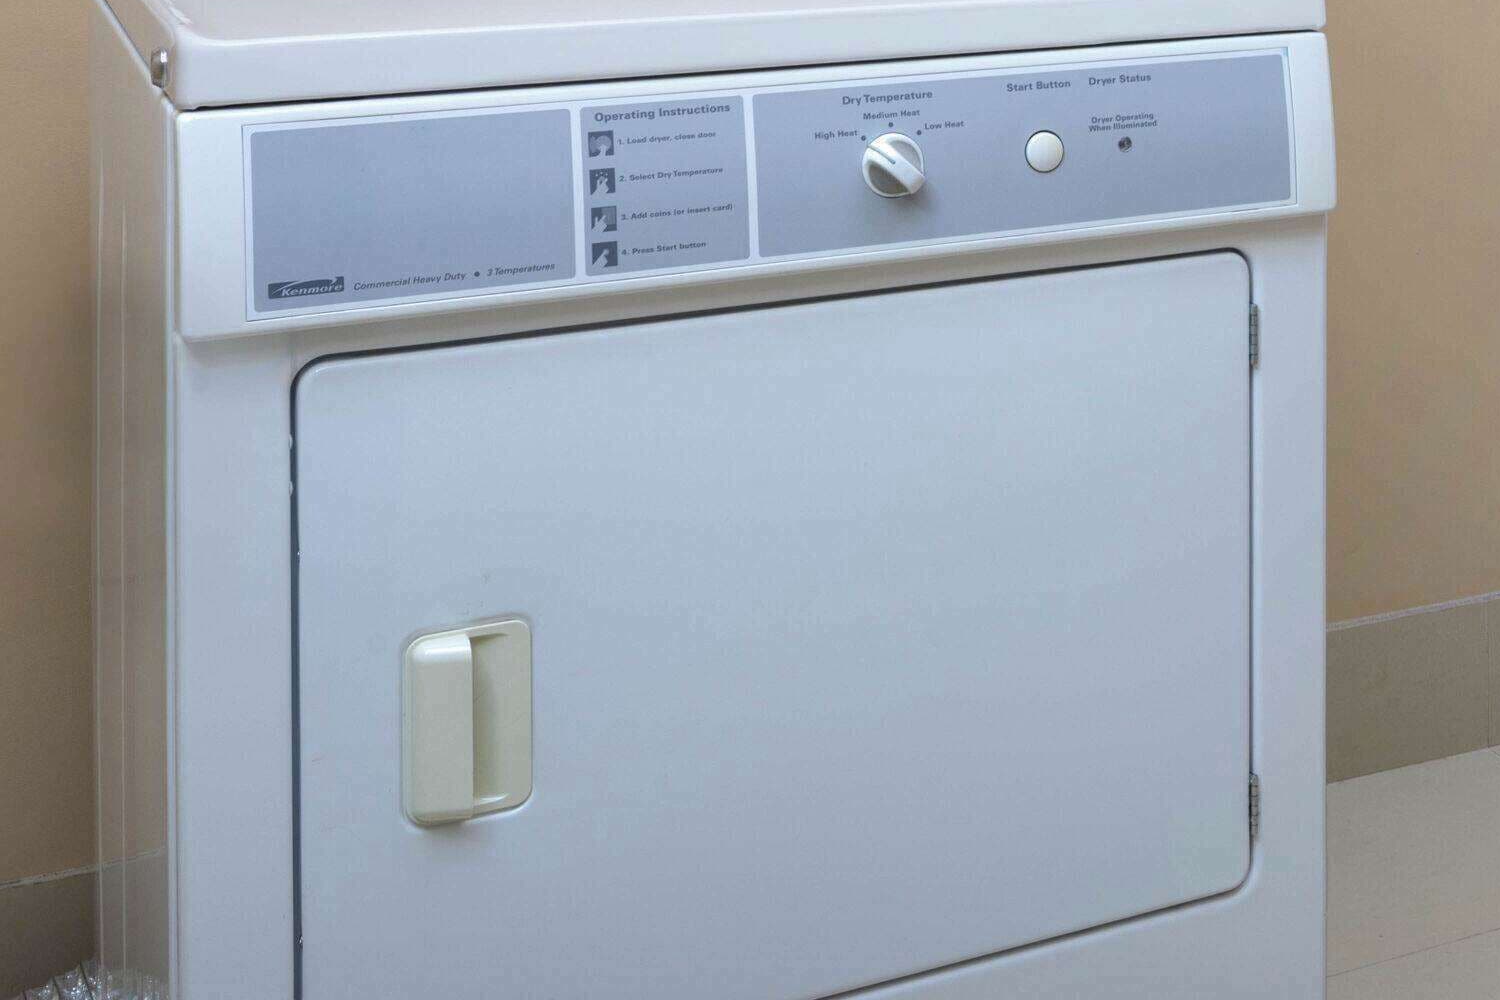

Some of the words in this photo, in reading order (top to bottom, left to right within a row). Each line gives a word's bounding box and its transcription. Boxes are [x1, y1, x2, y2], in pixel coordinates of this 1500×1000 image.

[1006, 83, 1033, 93] Start
[1036, 80, 1071, 90] Button
[1088, 77, 1116, 87] Dryer
[1119, 74, 1151, 84] Status
[842, 95, 861, 106] Dry
[863, 90, 933, 104] Temperature
[594, 109, 655, 123] Operating
[659, 104, 731, 118] Instructions
[863, 112, 898, 120] Medium
[900, 109, 920, 117] Heat
[1091, 115, 1113, 124] Dryer
[1115, 112, 1154, 122] Operating
[924, 122, 942, 131] Low
[944, 120, 964, 128] Heat
[1089, 124, 1111, 133] When
[1113, 120, 1157, 131] Illuminated
[627, 136, 647, 145] Load
[674, 132, 696, 141] close
[698, 131, 716, 139] door
[814, 131, 835, 141] High
[837, 129, 858, 137] Heat
[629, 173, 655, 182] Select
[657, 172, 673, 180] Dry
[674, 168, 724, 179] Temperature
[631, 211, 648, 220] Add
[650, 210, 672, 218] coins
[673, 208, 685, 217] (or
[687, 206, 711, 215] insert
[712, 203, 733, 212] card)
[632, 246, 655, 255] Press
[656, 244, 677, 253] Start
[679, 241, 706, 250] button
[353, 277, 412, 291] Commercial
[413, 274, 442, 286] Heavy
[444, 272, 467, 281] Duty
[494, 263, 555, 276] Temperatures
[281, 283, 343, 297] Kenmore
